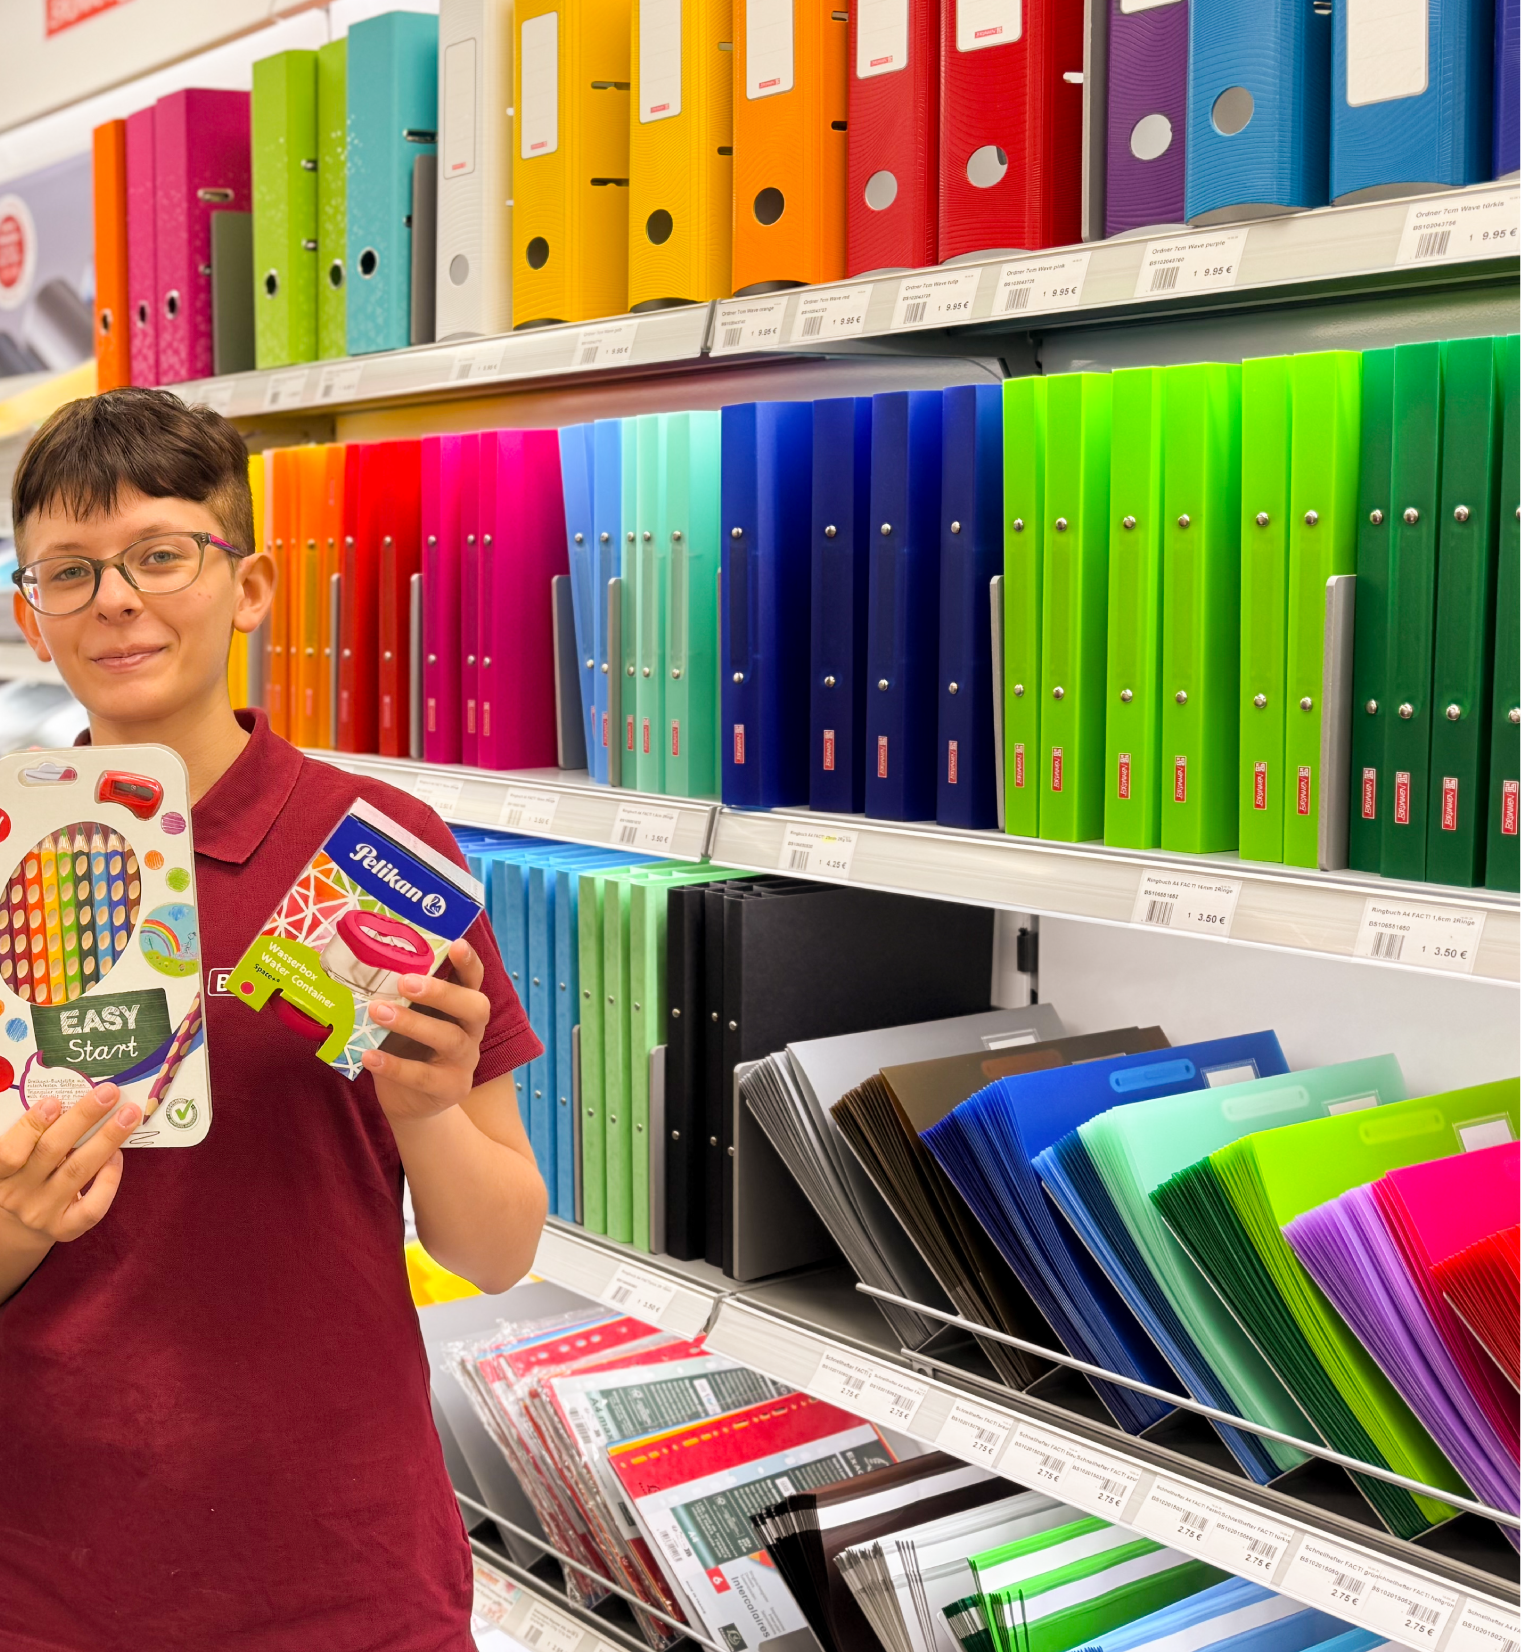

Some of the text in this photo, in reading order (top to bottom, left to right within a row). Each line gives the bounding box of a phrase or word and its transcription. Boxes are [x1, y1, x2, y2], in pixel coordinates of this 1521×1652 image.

[1415, 210, 1441, 218] Ordner
[1483, 201, 1504, 209] türkis
[1482, 229, 1507, 240] 9.95
[1509, 228, 1517, 236] €
[1151, 246, 1173, 254] Ordner
[1205, 240, 1225, 248] purple
[1007, 268, 1025, 276] Ordner
[1053, 263, 1065, 272] pink
[1203, 266, 1223, 276] 9.95
[1225, 266, 1233, 274] €
[1051, 288, 1069, 296] 9.95
[1071, 286, 1077, 294] €
[945, 302, 962, 311] 9.95
[840, 317, 855, 325] 9.95
[856, 316, 861, 324] €
[827, 860, 847, 870] 4.25 €
[349, 844, 423, 903] Pelikan
[1147, 877, 1171, 886] Ringbuch
[1214, 886, 1233, 894] 2Ringe
[1197, 913, 1217, 924] 3.50
[1219, 916, 1225, 925] €
[1371, 907, 1401, 916] Ringbuch
[1433, 915, 1451, 923] 1,6cm
[1453, 918, 1475, 926] 2Ringe
[1434, 946, 1457, 958] 3.50
[1460, 950, 1467, 960] €
[268, 941, 319, 982] Wasserbox
[261, 952, 335, 1010] Water Container
[59, 1004, 140, 1035] EASY
[66, 1036, 139, 1063] Start
[825, 1354, 854, 1370] Schnellhefter
[841, 1387, 854, 1398] 2.75
[591, 1397, 615, 1443] A4 max
[890, 1408, 903, 1418] 2.75
[956, 1406, 983, 1420] Schnellhefter
[973, 1442, 987, 1452] 2.75
[1019, 1431, 1050, 1448] Schnellhefter
[1077, 1455, 1109, 1472] Schnellhefter
[1037, 1468, 1053, 1480] 2.75
[1098, 1492, 1121, 1507] 2.75 €
[1156, 1484, 1185, 1500] Schnellhefter
[1221, 1512, 1257, 1530] Schnellhefter
[688, 1531, 699, 1543] A4
[1177, 1526, 1203, 1542] 2.75 €
[1245, 1554, 1272, 1570] 2.75 €
[1305, 1544, 1344, 1566] Schnellhefter
[1364, 1570, 1379, 1580] grün
[713, 1576, 723, 1585] 6
[1331, 1588, 1359, 1606] 2.75 €
[1379, 1574, 1412, 1592] chnellhefter
[1431, 1594, 1455, 1608] hellgrün
[731, 1576, 771, 1638] Intercalaires
[1467, 1608, 1513, 1630] Schnellhefter A4
[1405, 1619, 1435, 1637] 2.75 €
